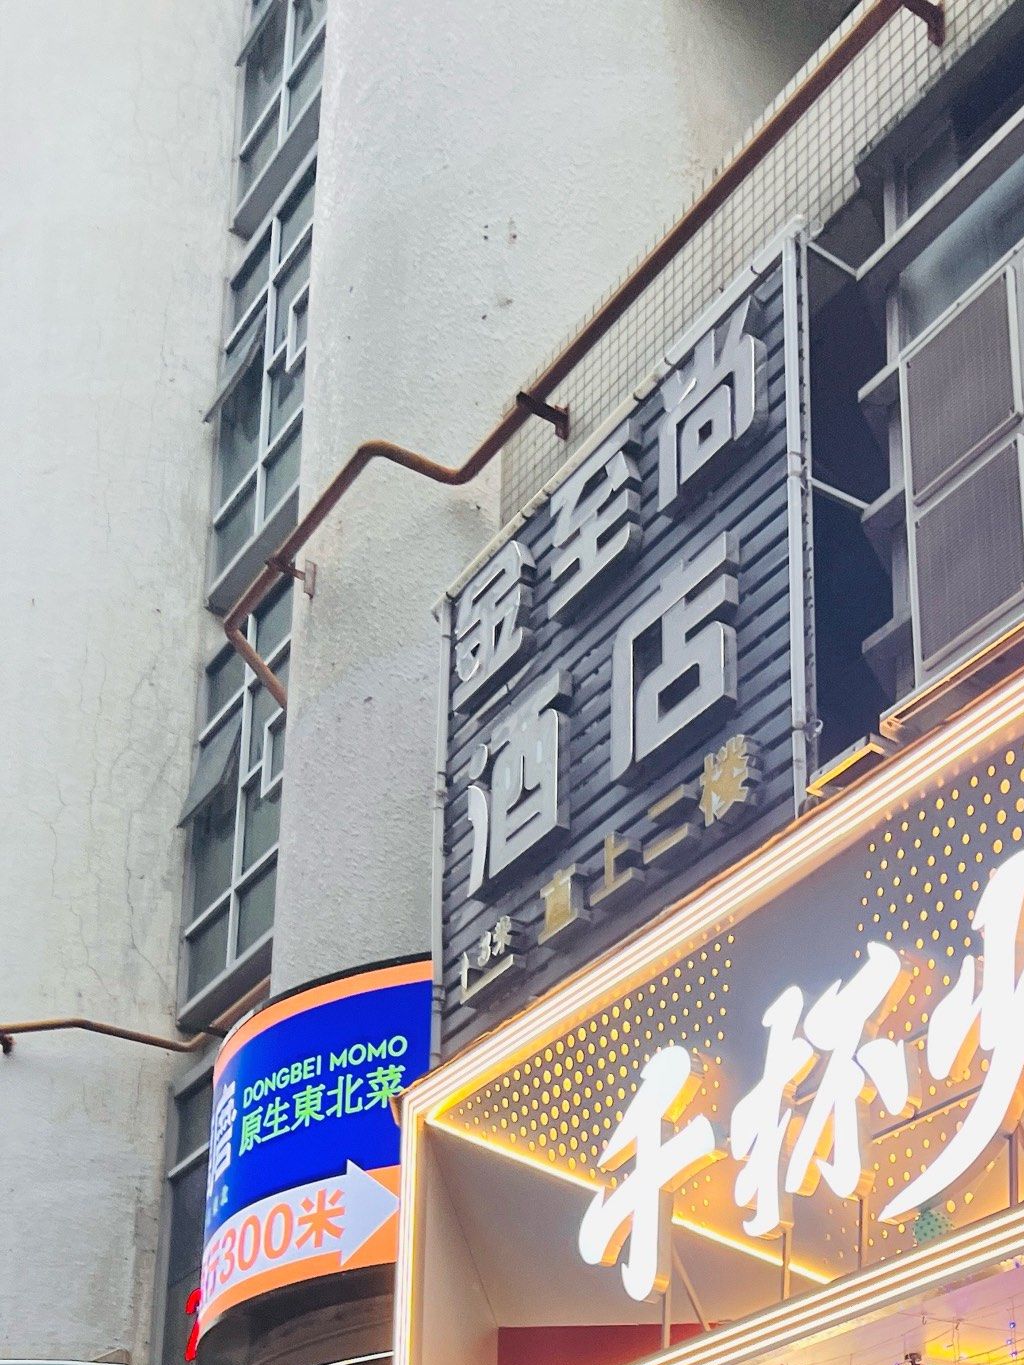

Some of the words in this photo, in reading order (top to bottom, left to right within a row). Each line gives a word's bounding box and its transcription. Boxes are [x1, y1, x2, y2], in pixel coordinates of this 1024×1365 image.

[453, 296, 766, 715] 金至尚
[466, 531, 740, 900] 酒店
[239, 1064, 406, 1157] 原生東北菜
[243, 1055, 322, 1110] DONGBEI
[329, 1035, 408, 1072] MOMO
